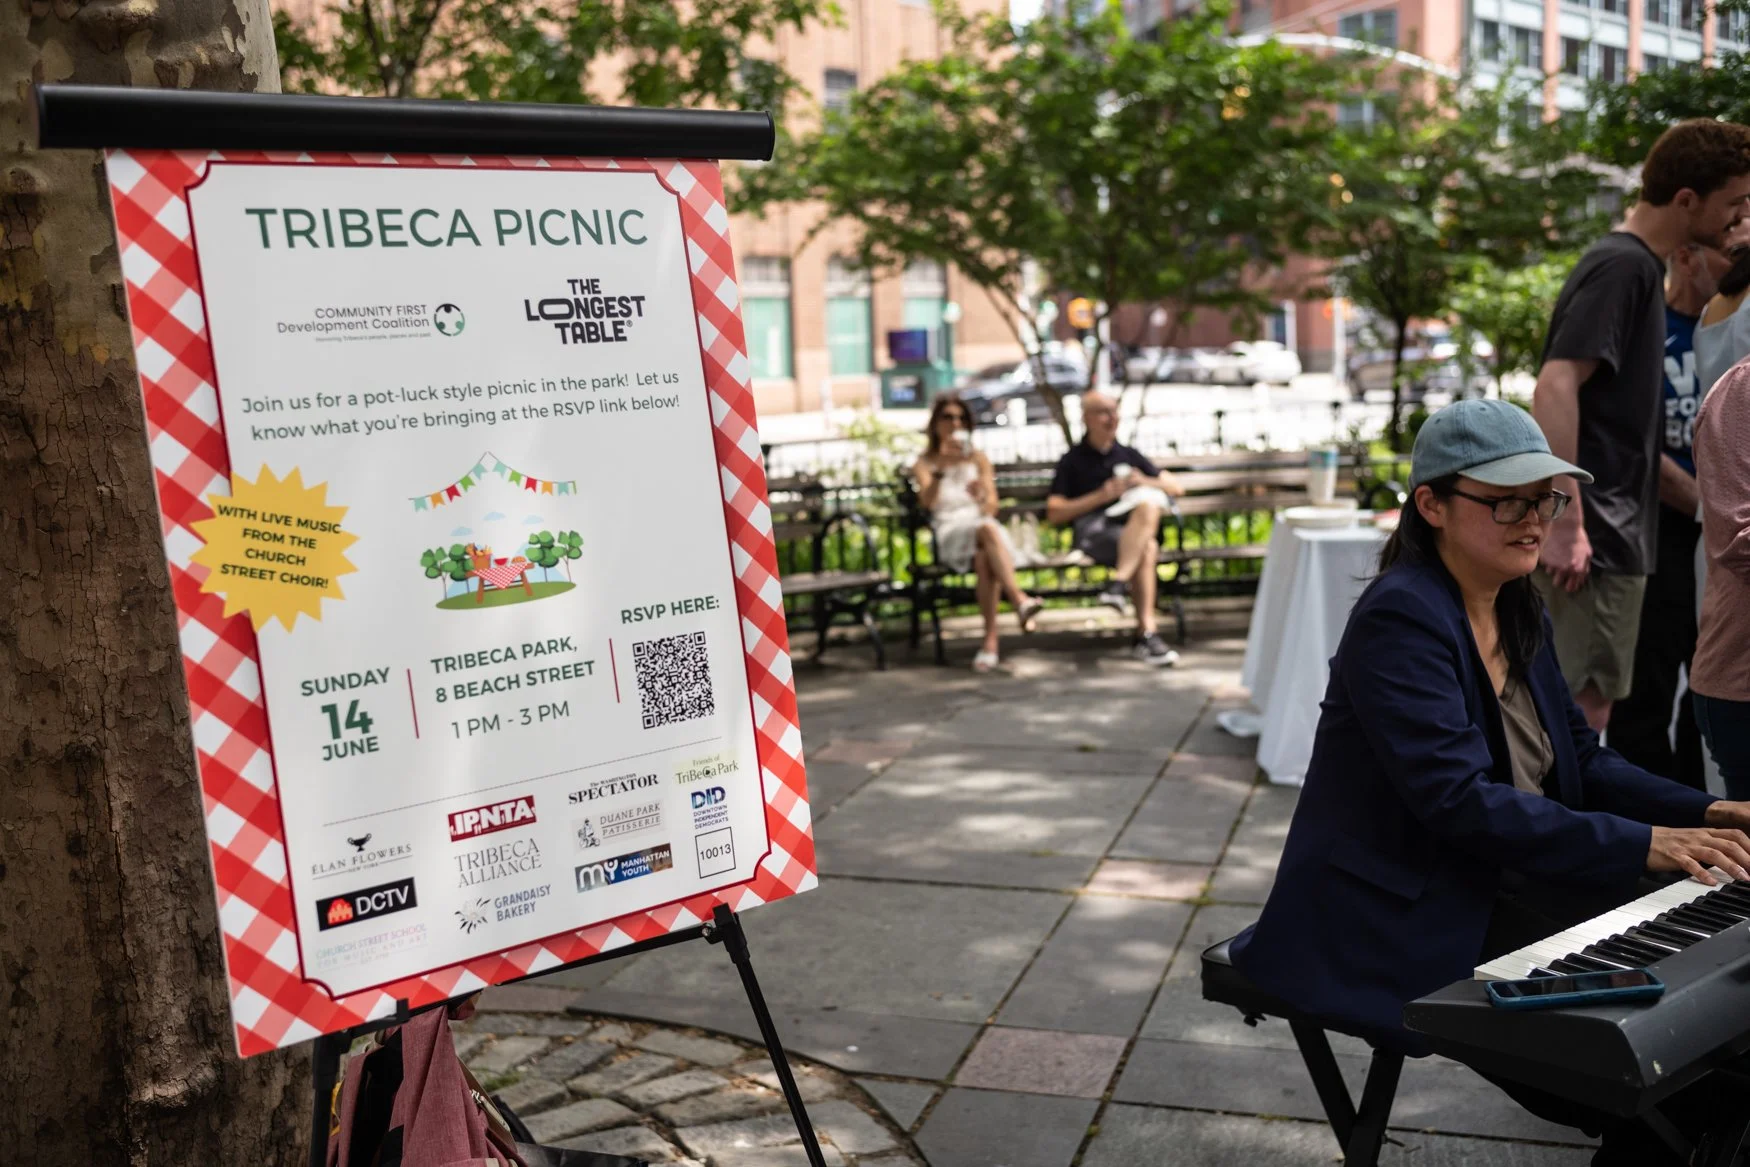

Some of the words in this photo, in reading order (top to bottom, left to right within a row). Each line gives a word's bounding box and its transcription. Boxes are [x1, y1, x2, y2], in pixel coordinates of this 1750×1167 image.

[245, 208, 482, 249] TRIBECA
[494, 208, 648, 246] PICNIC
[567, 278, 602, 295] THE
[315, 305, 392, 319] COMMUNITY
[396, 304, 427, 316] FIRST
[524, 296, 646, 321] LONGEST
[278, 320, 368, 334] Development
[372, 317, 430, 329] Coalition
[242, 396, 284, 413] Join
[290, 397, 312, 410] us
[316, 392, 342, 408] for
[348, 394, 358, 406] a
[363, 386, 439, 408] pot-luck
[443, 382, 482, 401] style
[487, 378, 538, 398] picnic
[541, 378, 557, 392] in
[561, 376, 587, 391] the
[592, 373, 628, 391] park!
[636, 372, 659, 386] Let
[662, 372, 679, 384] us
[251, 425, 305, 441] know
[311, 419, 360, 436] what
[364, 415, 419, 435] you're
[424, 409, 496, 428] bringing
[501, 407, 517, 421] at
[522, 404, 549, 419] the
[553, 400, 596, 417] RSVP
[599, 398, 628, 413] link
[631, 395, 680, 411] below!
[218, 504, 258, 521] WITH
[261, 512, 293, 527] LIVE
[296, 518, 342, 534] MUSIC
[242, 527, 285, 544] FROM
[289, 535, 317, 549] THE
[245, 548, 307, 566] CHURCH
[220, 563, 276, 580] STREET
[280, 572, 329, 589] CHOIR!
[621, 603, 666, 625] RSVP
[671, 595, 721, 616] HERE:
[431, 646, 518, 674] TRIBECA
[521, 636, 578, 658] PARK,
[301, 666, 390, 697] SUNDAY
[435, 687, 447, 703] 8
[453, 674, 521, 700] BEACH
[526, 660, 596, 688] STREET
[321, 699, 374, 740] 14
[451, 722, 461, 739] 1
[467, 713, 501, 736] PM
[520, 708, 532, 726] 3
[538, 701, 570, 722] PM
[322, 736, 380, 762] JUNE
[693, 756, 713, 767] Friends
[718, 760, 739, 775] Park
[568, 774, 659, 805] SPECTATOR
[691, 786, 726, 809] DID
[600, 808, 634, 825] DUANE
[636, 803, 660, 817] PARK
[693, 804, 728, 817] DOWNTOWN
[694, 810, 728, 824] INDEPENDENT
[695, 816, 729, 830] DEMOCRATS
[602, 815, 661, 836] PATISSERIE
[352, 844, 412, 866] FLOWERS
[454, 838, 540, 872] TRIBECA
[621, 850, 670, 870] MANHATTAN
[700, 843, 732, 861] 10013
[458, 854, 542, 888] ALLIANCE
[622, 864, 650, 878] YOUTH
[355, 885, 409, 915] DCTV
[494, 884, 551, 909] GRANDAISY
[496, 901, 536, 922] BAKERY
[316, 939, 356, 959] CHURCH
[358, 933, 391, 948] STREET
[391, 922, 427, 939] SCHOOL
